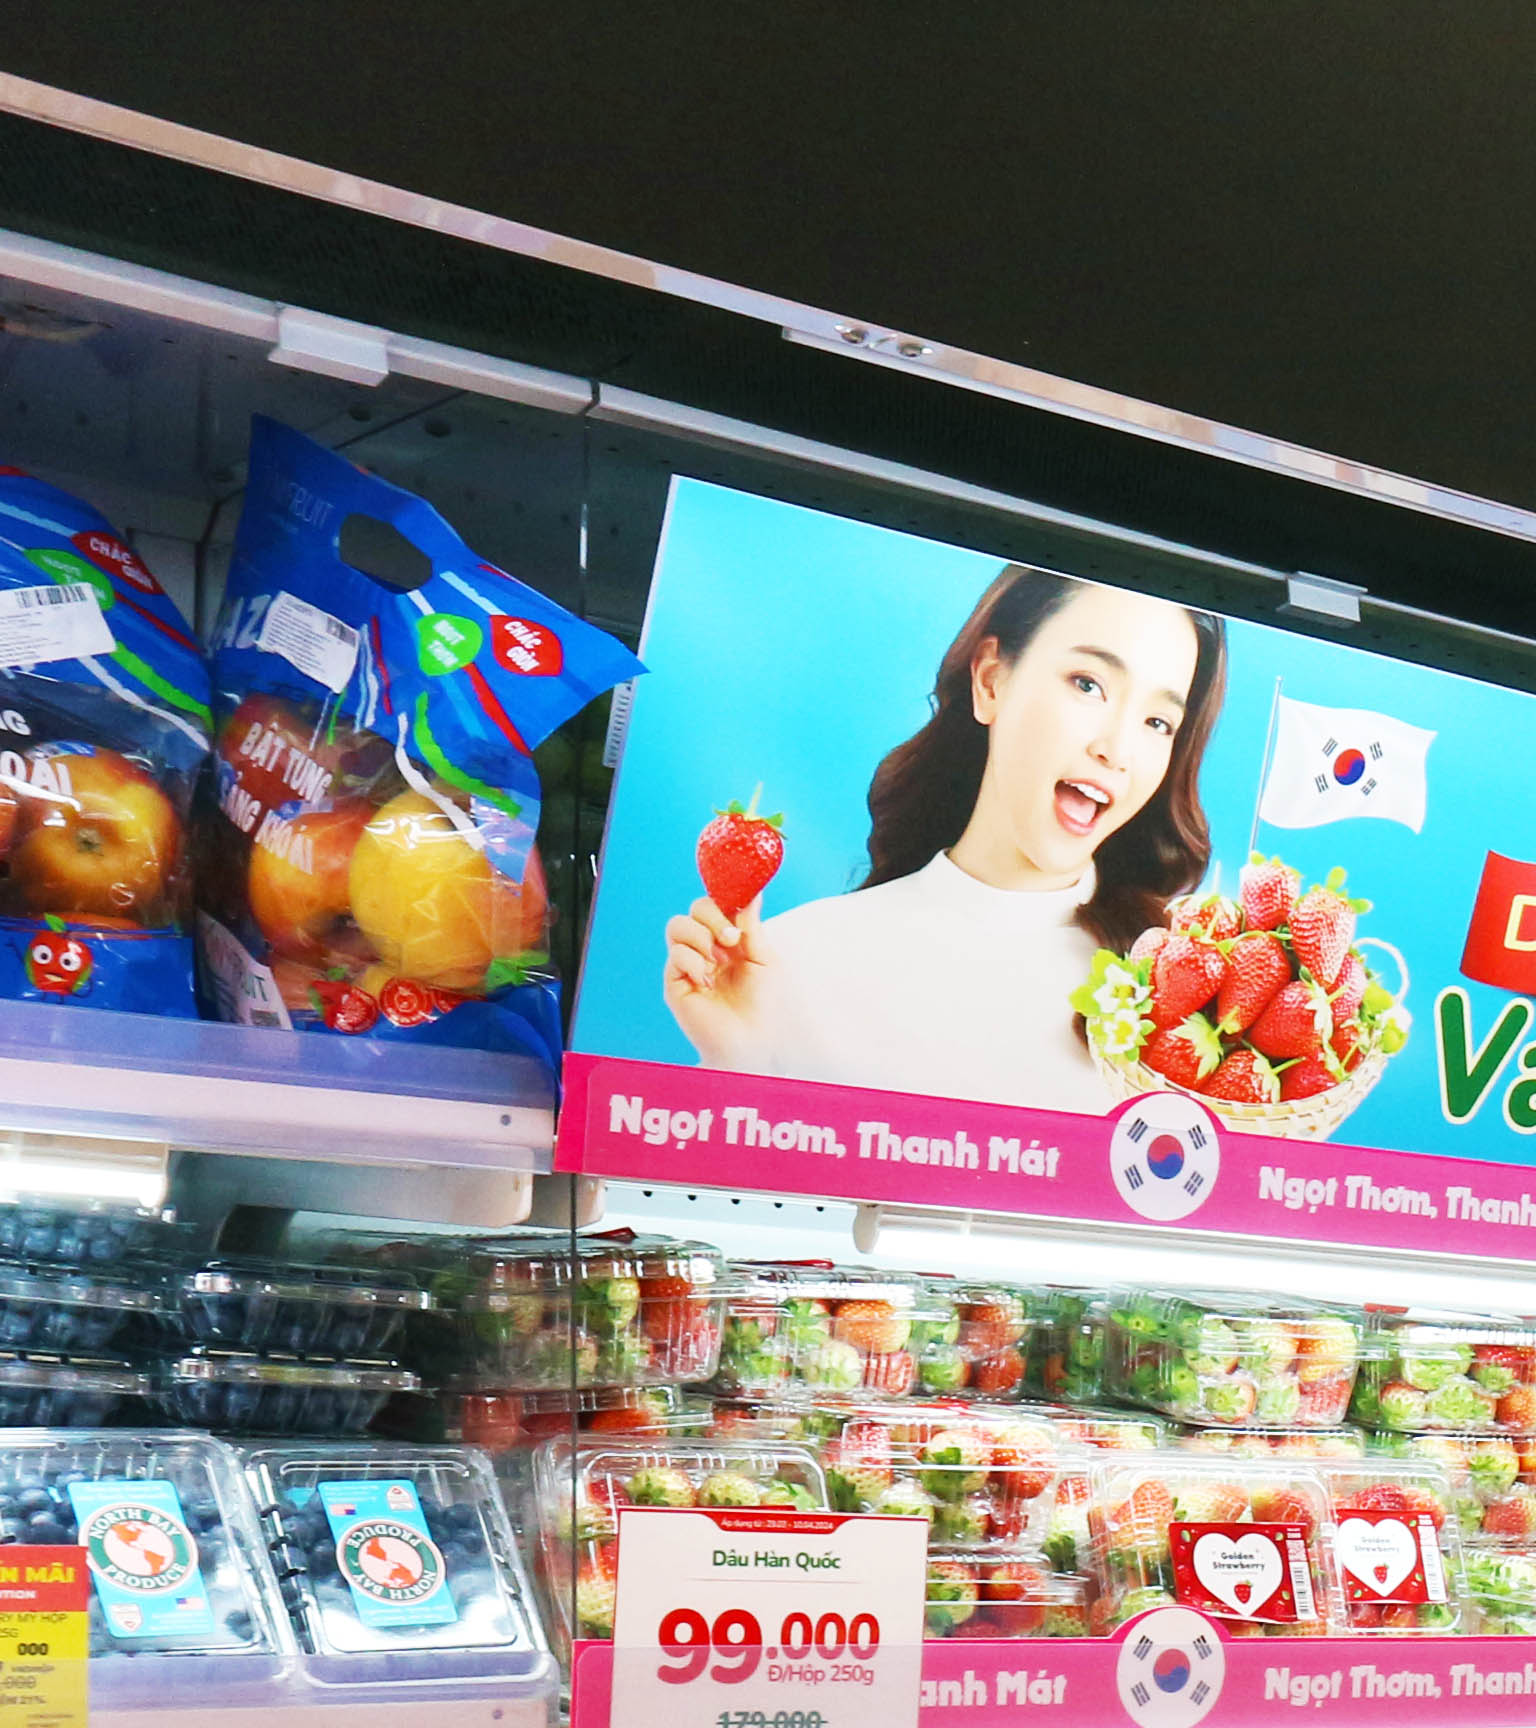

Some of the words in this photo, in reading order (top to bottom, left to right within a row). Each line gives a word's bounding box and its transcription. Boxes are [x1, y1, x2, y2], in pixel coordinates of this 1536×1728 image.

[609, 1094, 711, 1151] Ngọt
[721, 1104, 845, 1160] Thơm,
[857, 1120, 979, 1170] Thanh
[989, 1135, 1060, 1180] Mát
[1259, 1166, 1338, 1216] Ngọt
[1345, 1173, 1437, 1222] Thơm,
[89, 1506, 144, 1539] NORTH
[148, 1510, 181, 1538] BAY
[346, 1524, 423, 1549] PRODUCE
[712, 1549, 750, 1569] Dâu
[753, 1549, 790, 1569] Hàn
[795, 1547, 841, 1572] Quốc
[1212, 1561, 1266, 1573] Strawberry
[1221, 1551, 1255, 1562] Golden
[26, 1563, 75, 1584] MÃI
[102, 1562, 186, 1590] PRODUCE
[352, 1572, 396, 1601] BAY
[397, 1569, 438, 1601] NORTH
[657, 1607, 880, 1685] 99.000
[767, 1664, 825, 1686] Đ/Hộp
[831, 1663, 874, 1686] 250g
[1264, 1666, 1343, 1709] Ngọt
[1349, 1662, 1442, 1700] Thơm,
